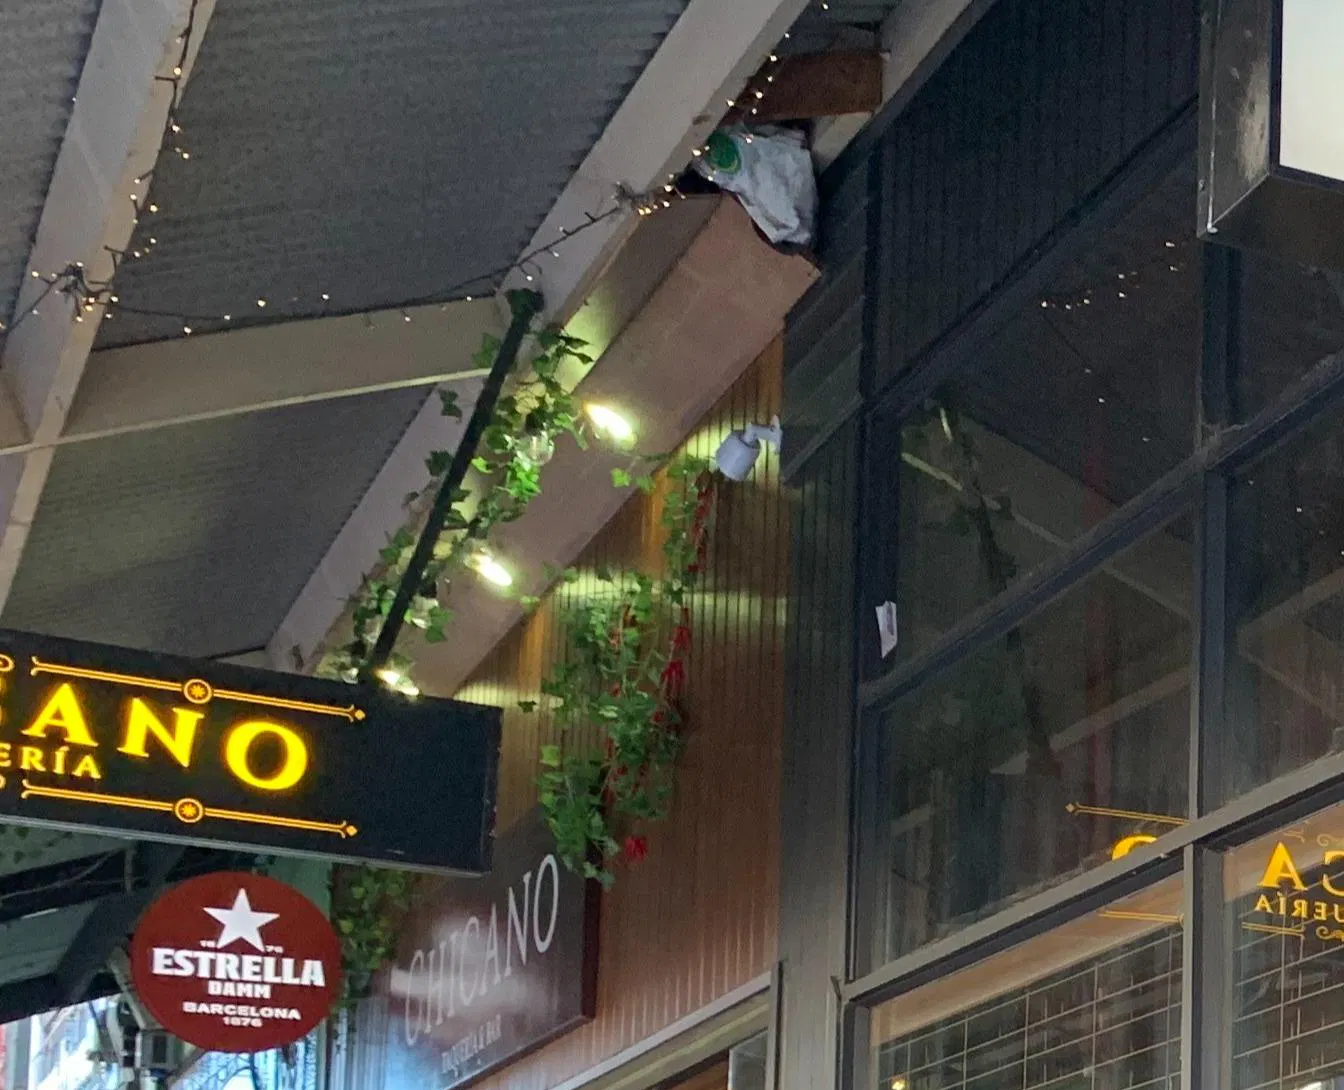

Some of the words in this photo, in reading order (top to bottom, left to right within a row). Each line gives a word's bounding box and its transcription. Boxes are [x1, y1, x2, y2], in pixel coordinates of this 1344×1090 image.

[0, 682, 308, 790] ANO
[152, 946, 326, 987] ESTRELLA
[405, 853, 559, 1046] CHICANO
[208, 980, 272, 1000] DAMM
[182, 1002, 302, 1021] BARCELONA
